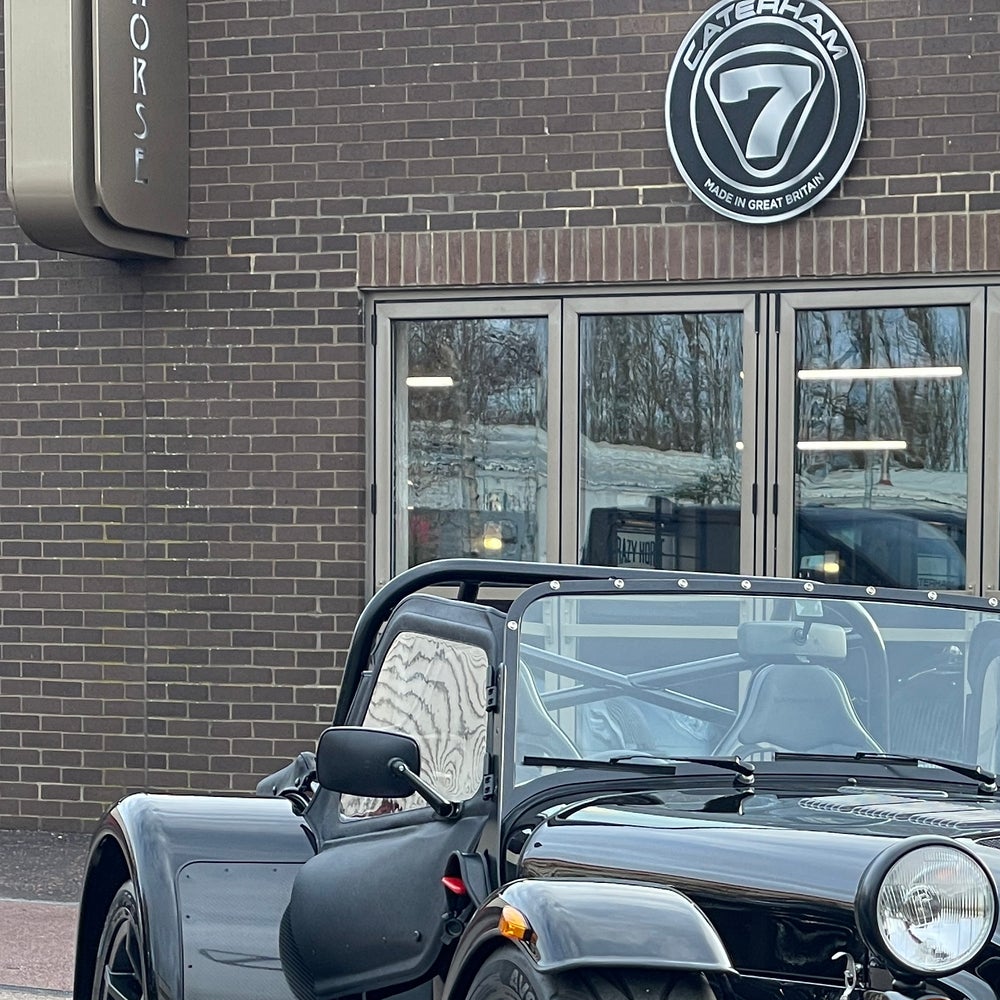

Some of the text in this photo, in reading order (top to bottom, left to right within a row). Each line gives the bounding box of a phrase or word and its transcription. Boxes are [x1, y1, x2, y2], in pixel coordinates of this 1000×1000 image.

[683, 0, 848, 71] CATERHAM
[130, 0, 149, 184] ORSE
[719, 64, 812, 159] 7
[703, 172, 826, 211] MADE IN GREAT BRITAIN
